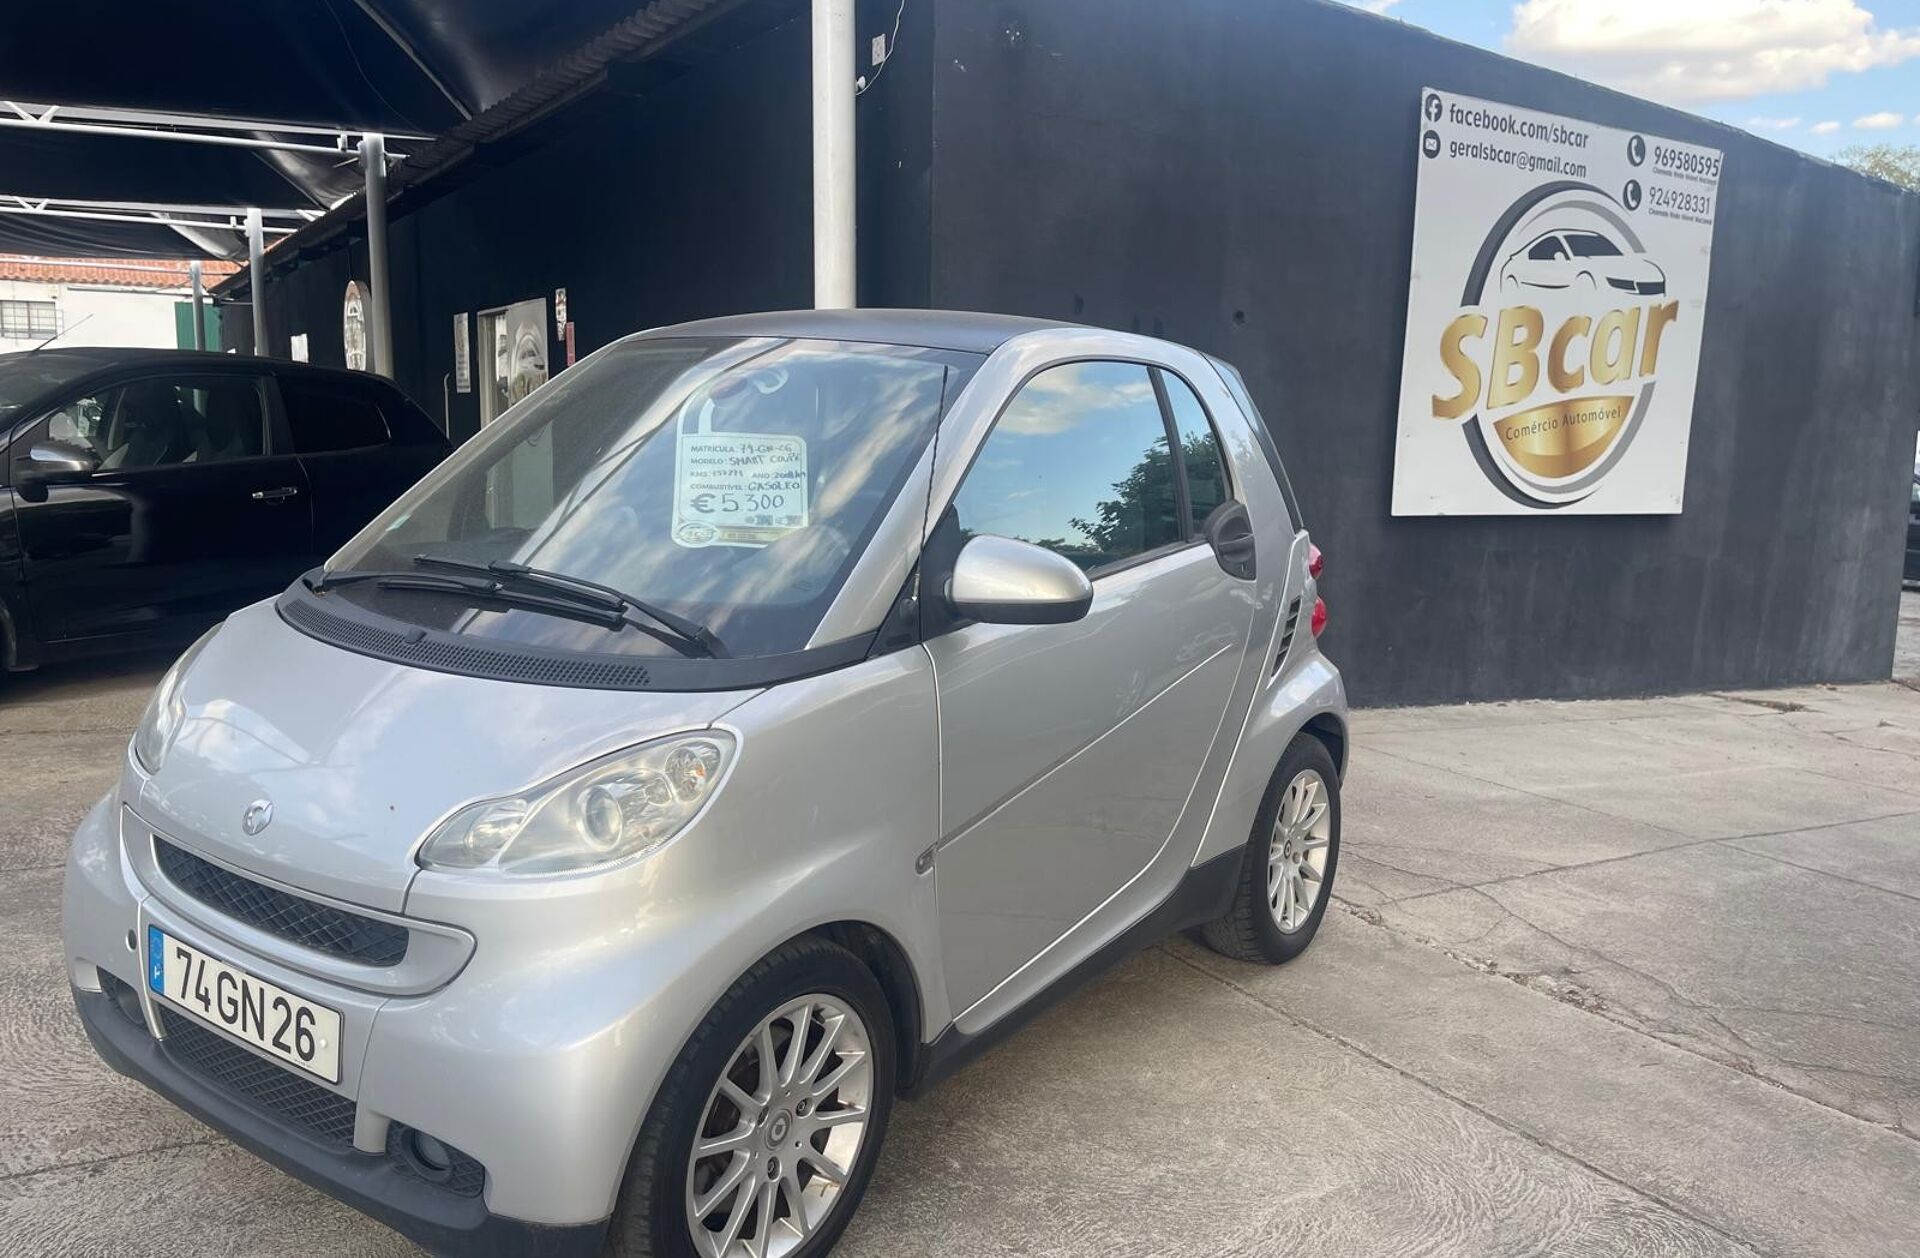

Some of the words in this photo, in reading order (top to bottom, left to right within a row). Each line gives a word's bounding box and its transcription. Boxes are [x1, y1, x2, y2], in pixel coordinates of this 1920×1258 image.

[1449, 103, 1589, 149] facebook.com/sbcar
[1449, 139, 1587, 178] geralsbcar@gmail.com
[1654, 146, 1720, 177] 969580595
[1649, 186, 1711, 215] 924928331
[1431, 299, 1680, 420] SBcar
[1505, 415, 1559, 441] Comércio
[1562, 406, 1622, 428] Automóvel
